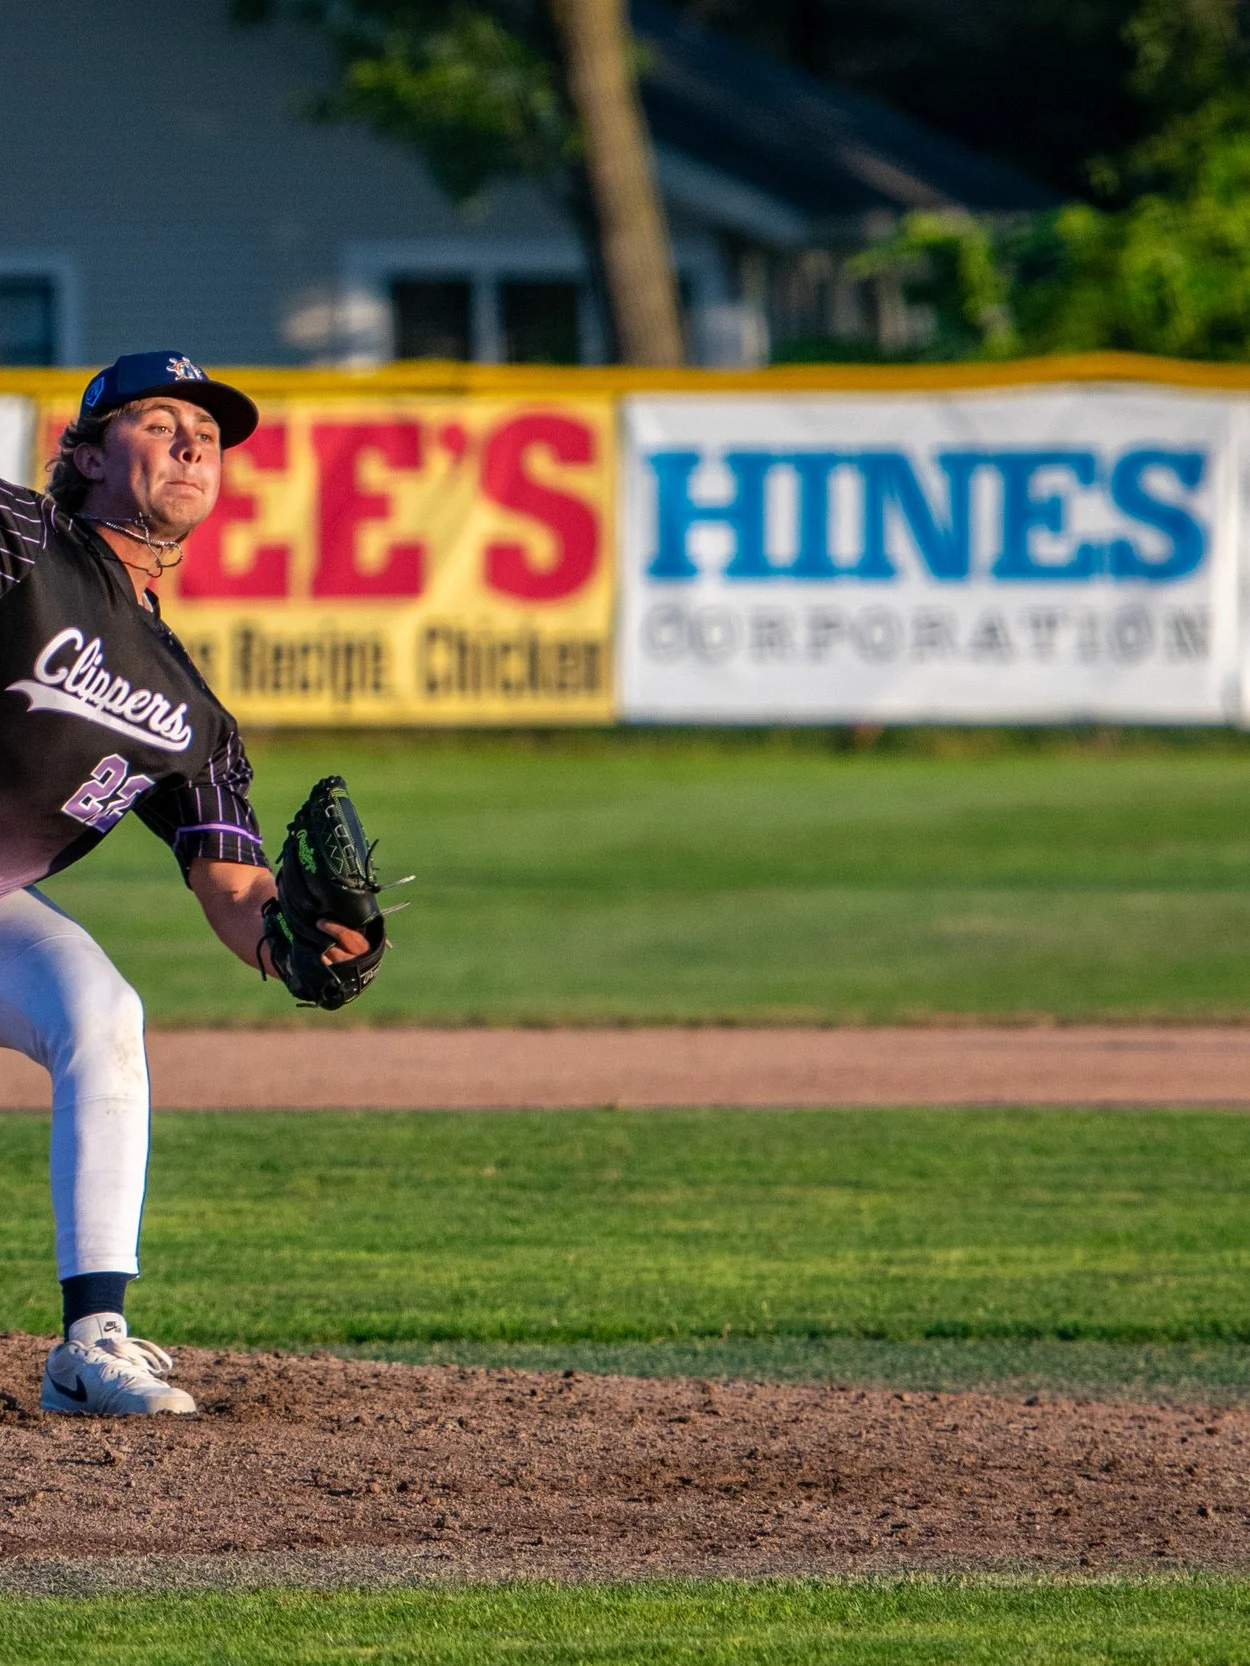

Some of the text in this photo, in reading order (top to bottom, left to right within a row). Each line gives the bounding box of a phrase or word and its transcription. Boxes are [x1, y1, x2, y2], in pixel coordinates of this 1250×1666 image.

[48, 412, 602, 603] EE'S
[646, 448, 1207, 582] HINES
[234, 622, 390, 707] Recipe
[420, 620, 603, 698] Chicken
[642, 606, 1211, 663] CORPORATION
[33, 627, 192, 745] Clippers
[61, 753, 155, 834] 22
